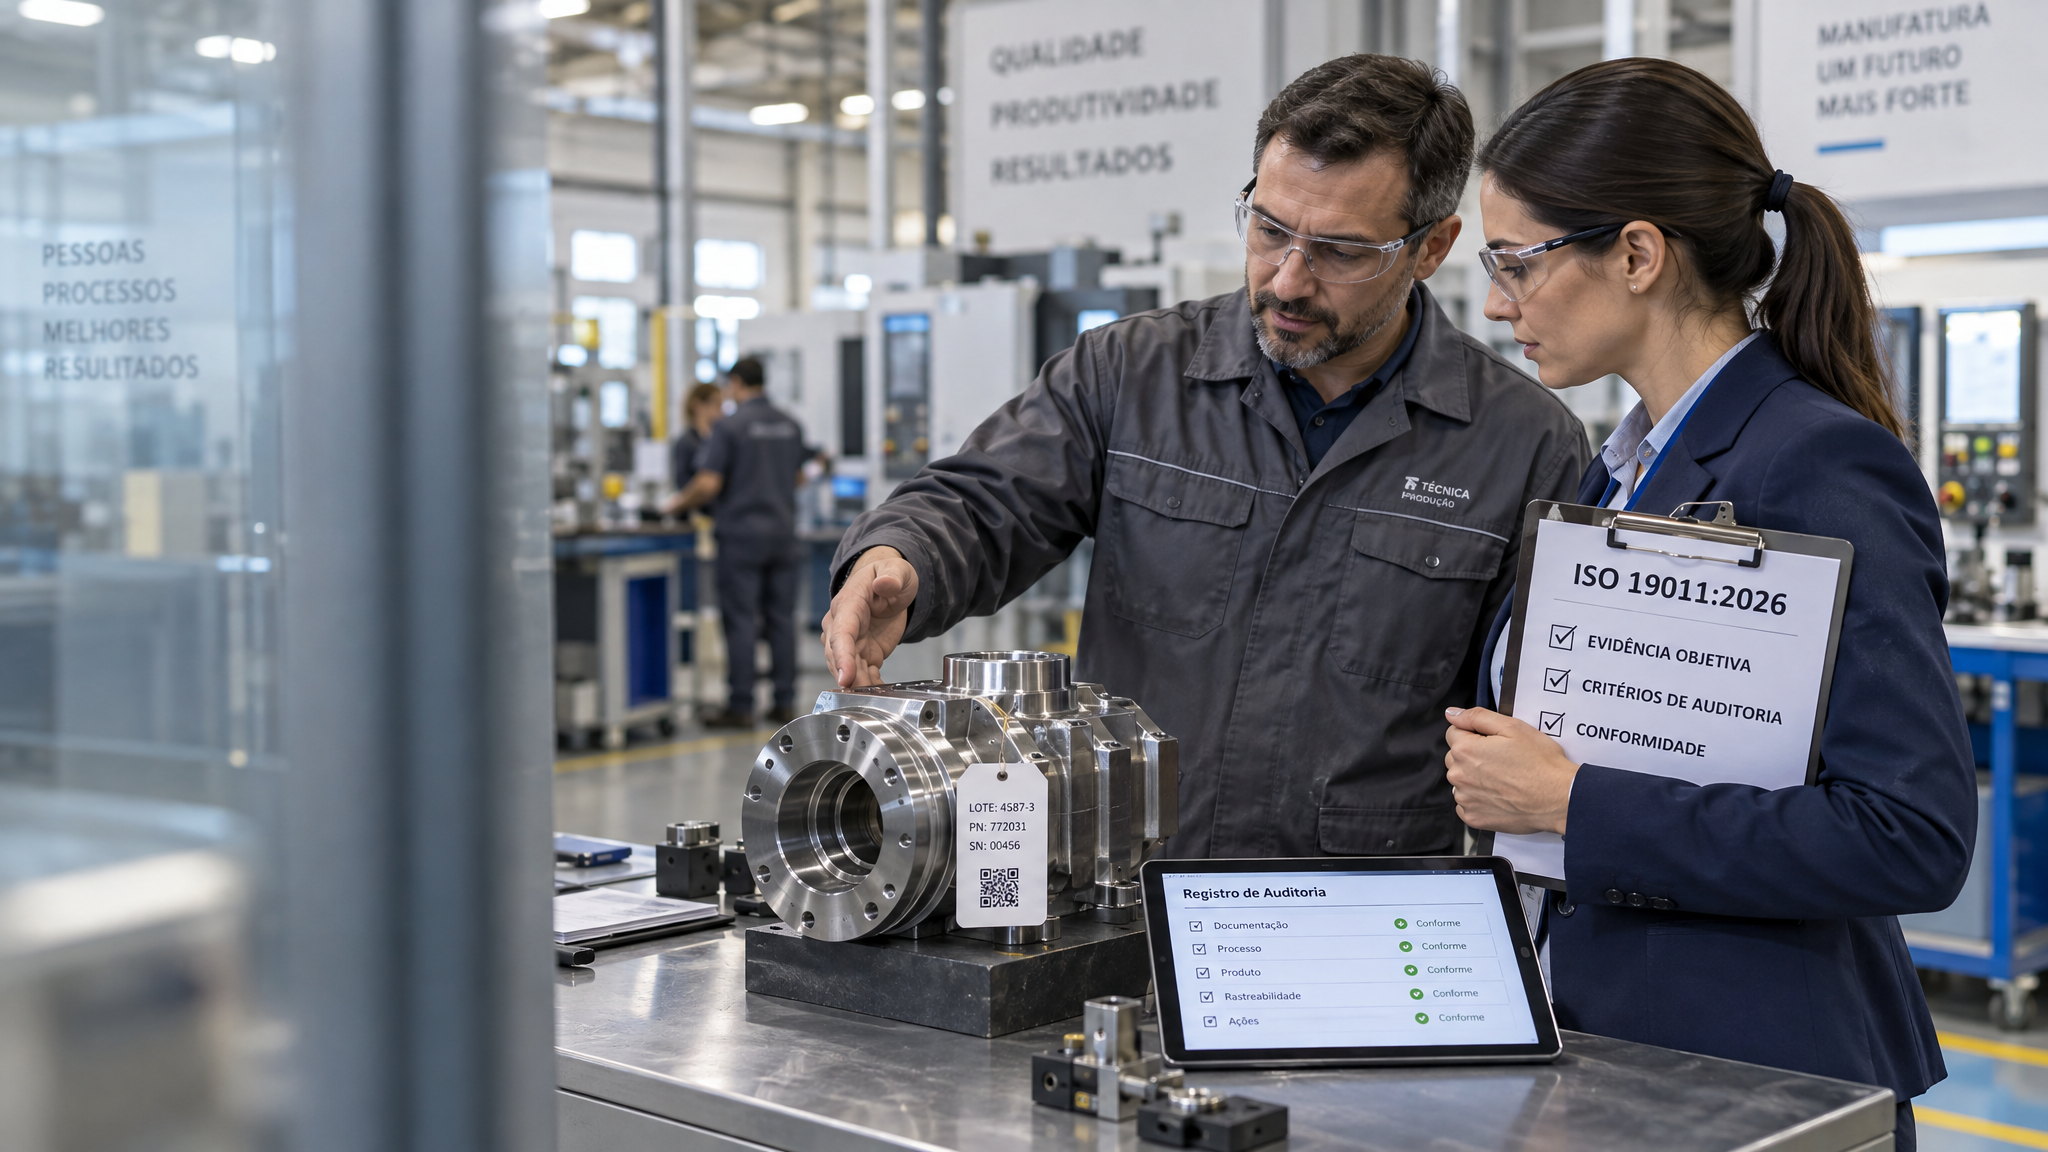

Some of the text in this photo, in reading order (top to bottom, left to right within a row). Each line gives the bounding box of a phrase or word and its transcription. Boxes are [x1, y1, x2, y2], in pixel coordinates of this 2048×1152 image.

[1818, 3, 1990, 46] MANUFATURA
[989, 27, 1143, 76] QUALIDADE
[1817, 44, 1962, 84] UM FUTURO
[990, 77, 1220, 128] PRODUTIVIDADE
[1817, 80, 1970, 118] MAIS FORTE
[990, 143, 1173, 185] RESULTADOS
[42, 239, 145, 267] PESSOAS
[42, 278, 176, 306] PROCESSOS
[43, 317, 170, 344] MELHORES
[1421, 480, 1470, 500] TÉCNICA
[1573, 563, 1788, 616] ISO 19011:2026
[1587, 634, 1752, 673] EVIDÊNCIA OBJETIVA
[1582, 679, 1783, 726] CRITÉRIOS DE AUDITORIA
[1576, 722, 1706, 758] CONFORMIDADE
[969, 803, 998, 813] LOTE:
[969, 821, 1027, 832] PN: 772031
[969, 840, 1021, 851] SN: 00456
[1183, 887, 1327, 901] Registro de Auditoria
[1213, 920, 1289, 931] Documentação
[1416, 919, 1461, 928] Conforme
[1217, 944, 1262, 953] Processo
[1421, 942, 1467, 951] Conforme
[1221, 968, 1261, 978] Produto
[1427, 965, 1473, 974] Conforme
[1224, 992, 1302, 1001] Rastreabilidade
[1432, 989, 1479, 998] Conforme
[1228, 1017, 1260, 1027] Ações
[1438, 1013, 1485, 1022] Conforme
